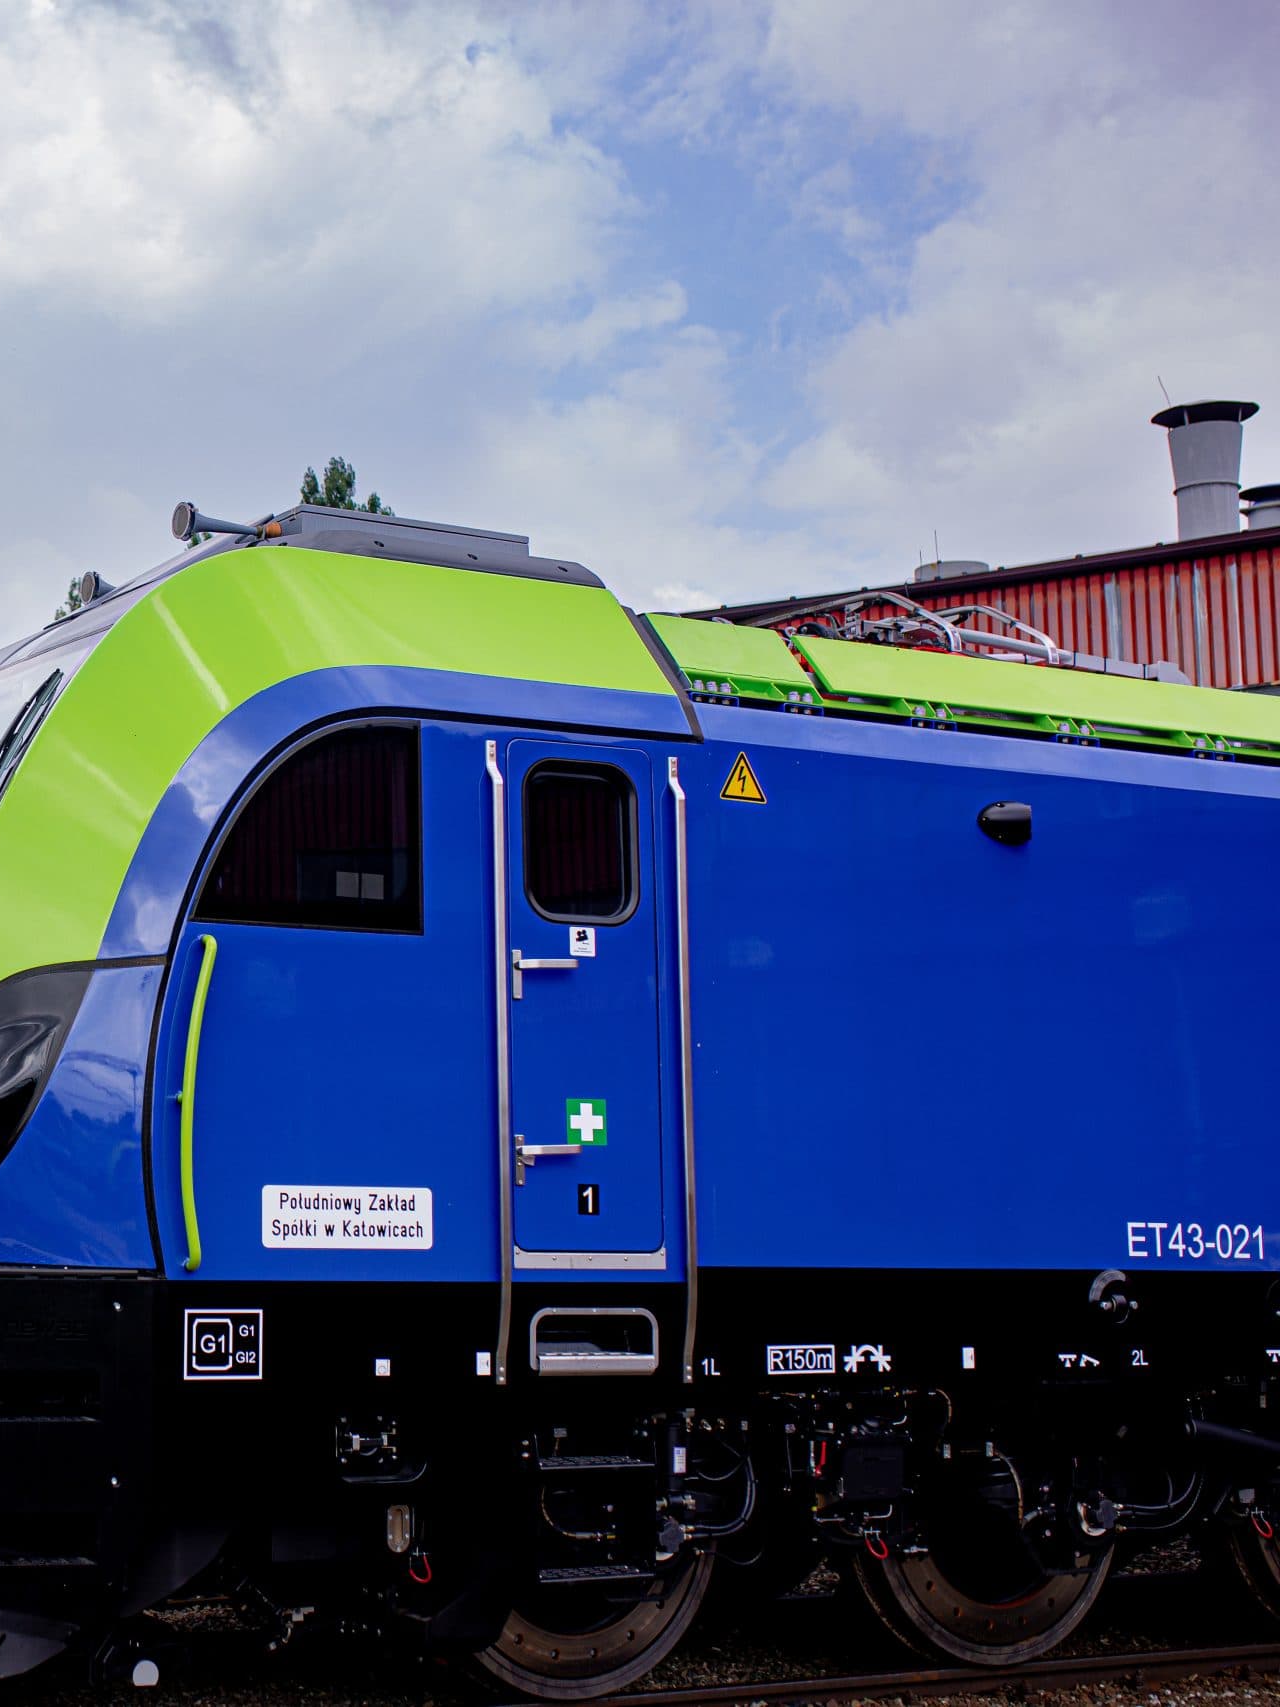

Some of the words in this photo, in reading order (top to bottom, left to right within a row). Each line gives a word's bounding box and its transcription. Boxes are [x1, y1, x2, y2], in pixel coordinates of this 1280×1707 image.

[279, 1192, 361, 1215] Południowy
[368, 1194, 416, 1212] Zakład
[582, 1186, 593, 1213] 1
[272, 1218, 317, 1241] Spółki
[325, 1224, 335, 1237] w
[342, 1220, 424, 1238] Katowicach
[1127, 1222, 1264, 1260] ET43-021
[238, 1324, 255, 1337] G1
[200, 1334, 225, 1354] G1
[701, 1357, 721, 1376] 1L
[769, 1349, 833, 1371] R150m
[1131, 1349, 1149, 1366] 2L
